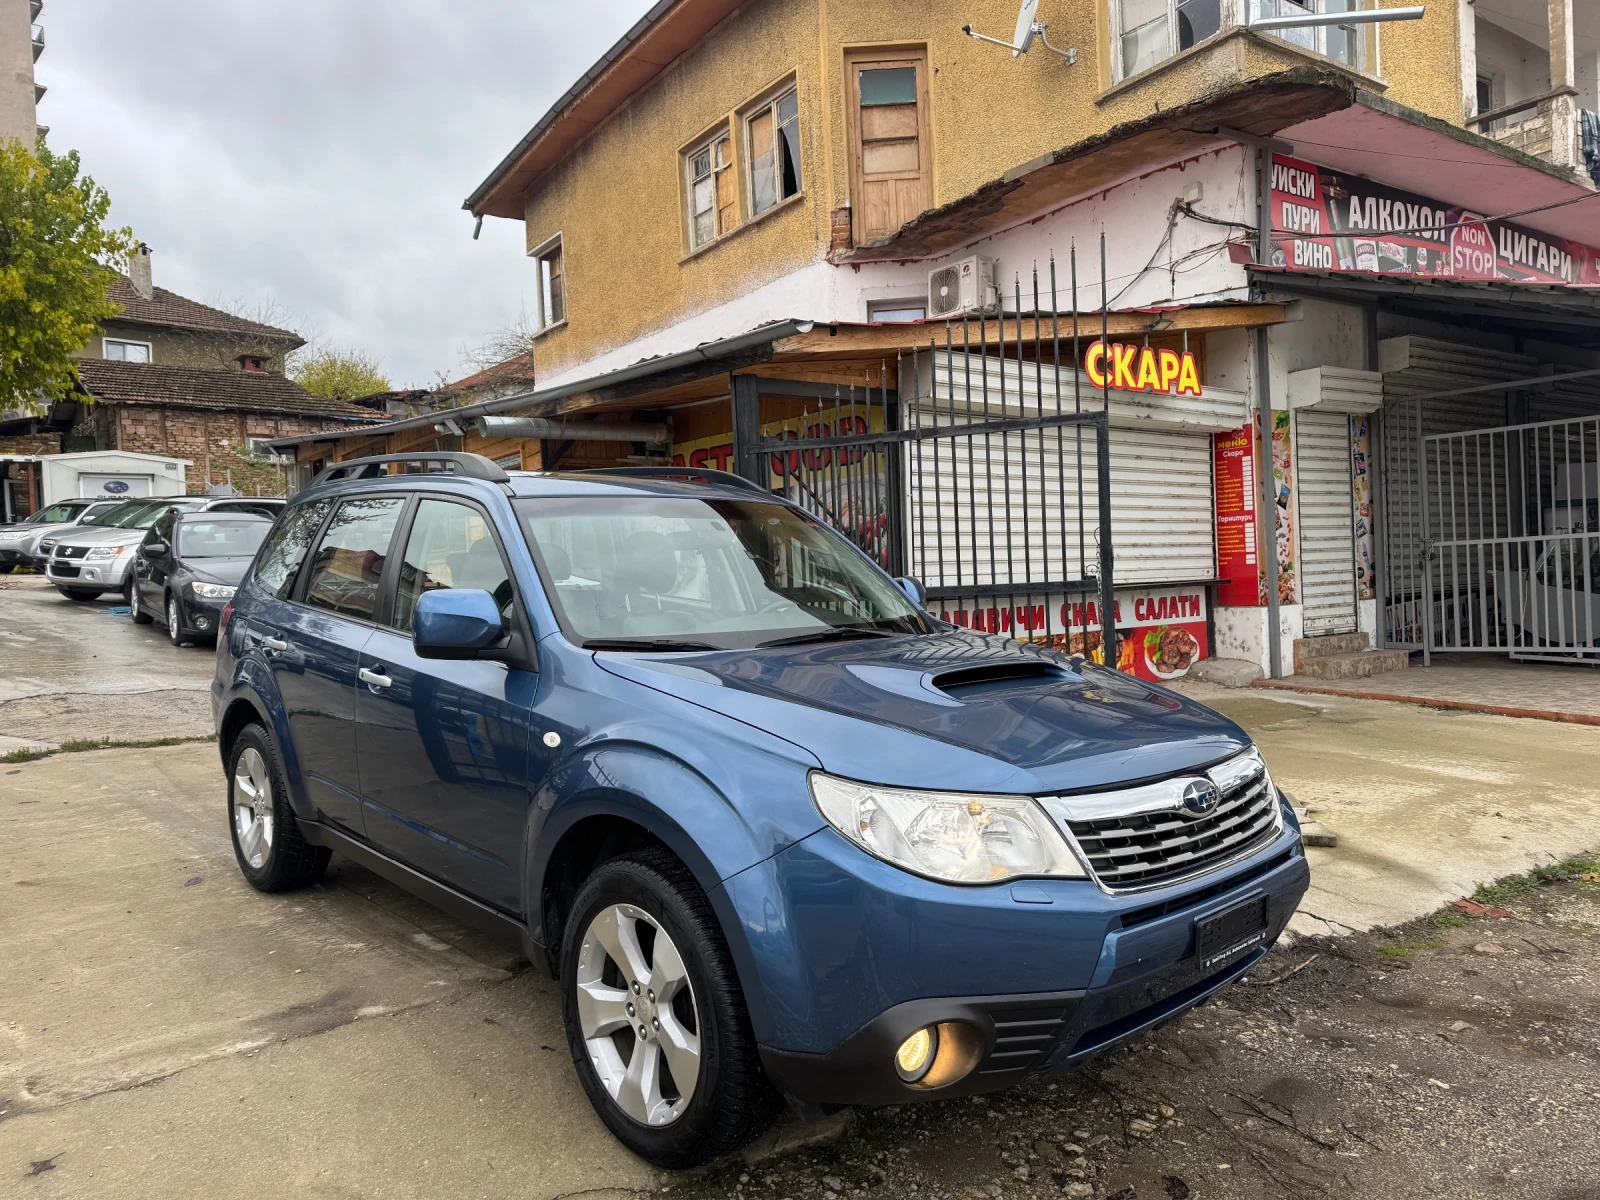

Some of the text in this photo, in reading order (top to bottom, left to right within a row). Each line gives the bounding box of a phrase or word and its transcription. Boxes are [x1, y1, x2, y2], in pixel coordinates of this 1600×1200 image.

[1271, 164, 1315, 199] УИСКИ
[1282, 201, 1320, 235] ПУРИ
[1348, 195, 1446, 242] АЛКОХОЛ
[1461, 226, 1485, 247] NON
[1294, 240, 1332, 268] ВИНО
[1454, 245, 1493, 275] STOP
[1499, 226, 1572, 282] ЦИГАРИ
[1085, 341, 1202, 396] СКАРА
[770, 416, 868, 477] OOD
[928, 605, 1045, 634] НДВИЧИ
[1135, 594, 1201, 621] САЛАТИ
